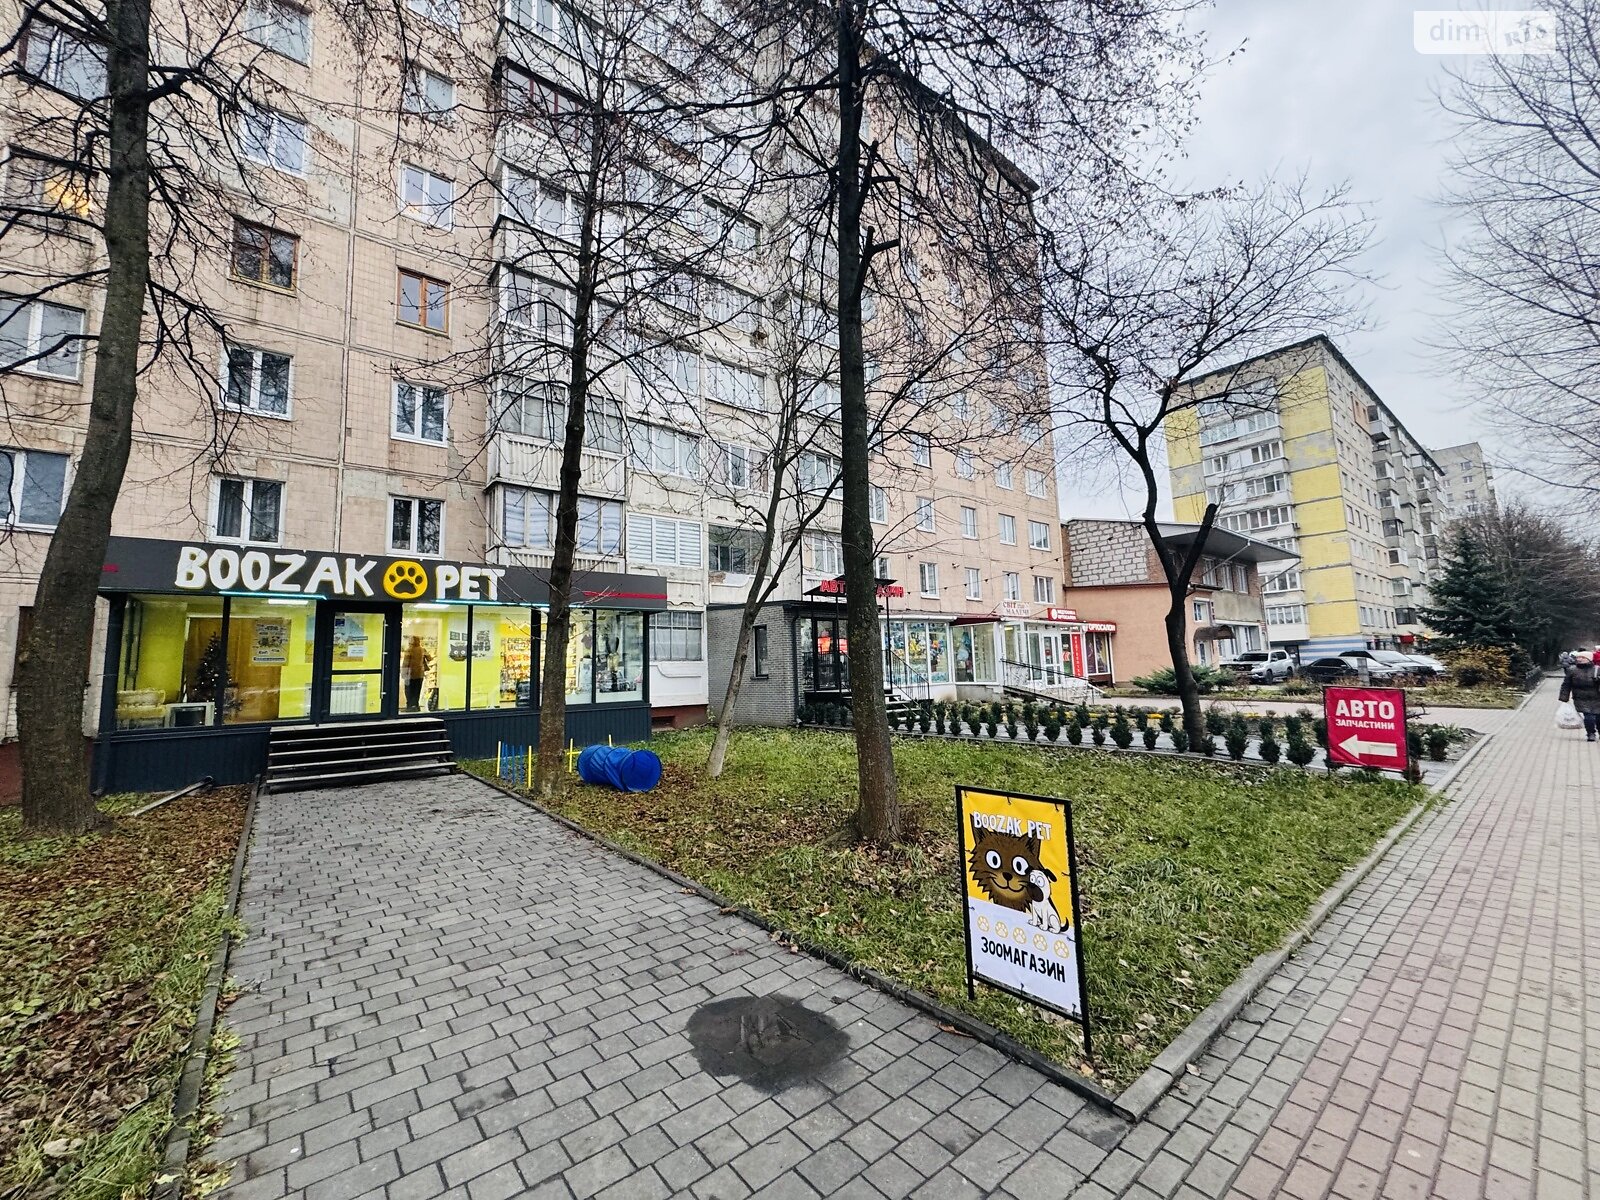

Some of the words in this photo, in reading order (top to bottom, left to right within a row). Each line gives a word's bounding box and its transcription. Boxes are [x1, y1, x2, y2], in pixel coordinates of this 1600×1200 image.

[174, 546, 378, 597] BOOZAK
[435, 564, 506, 601] PET
[819, 579, 905, 598] АВТАЗИН
[1335, 699, 1396, 720] АВТО
[1335, 719, 1395, 730] ЗАПЧАСТИНИ
[973, 810, 1022, 838] BOOZAK
[1026, 818, 1053, 842] PET
[980, 936, 1066, 984] ЗООМАГАЗИН
